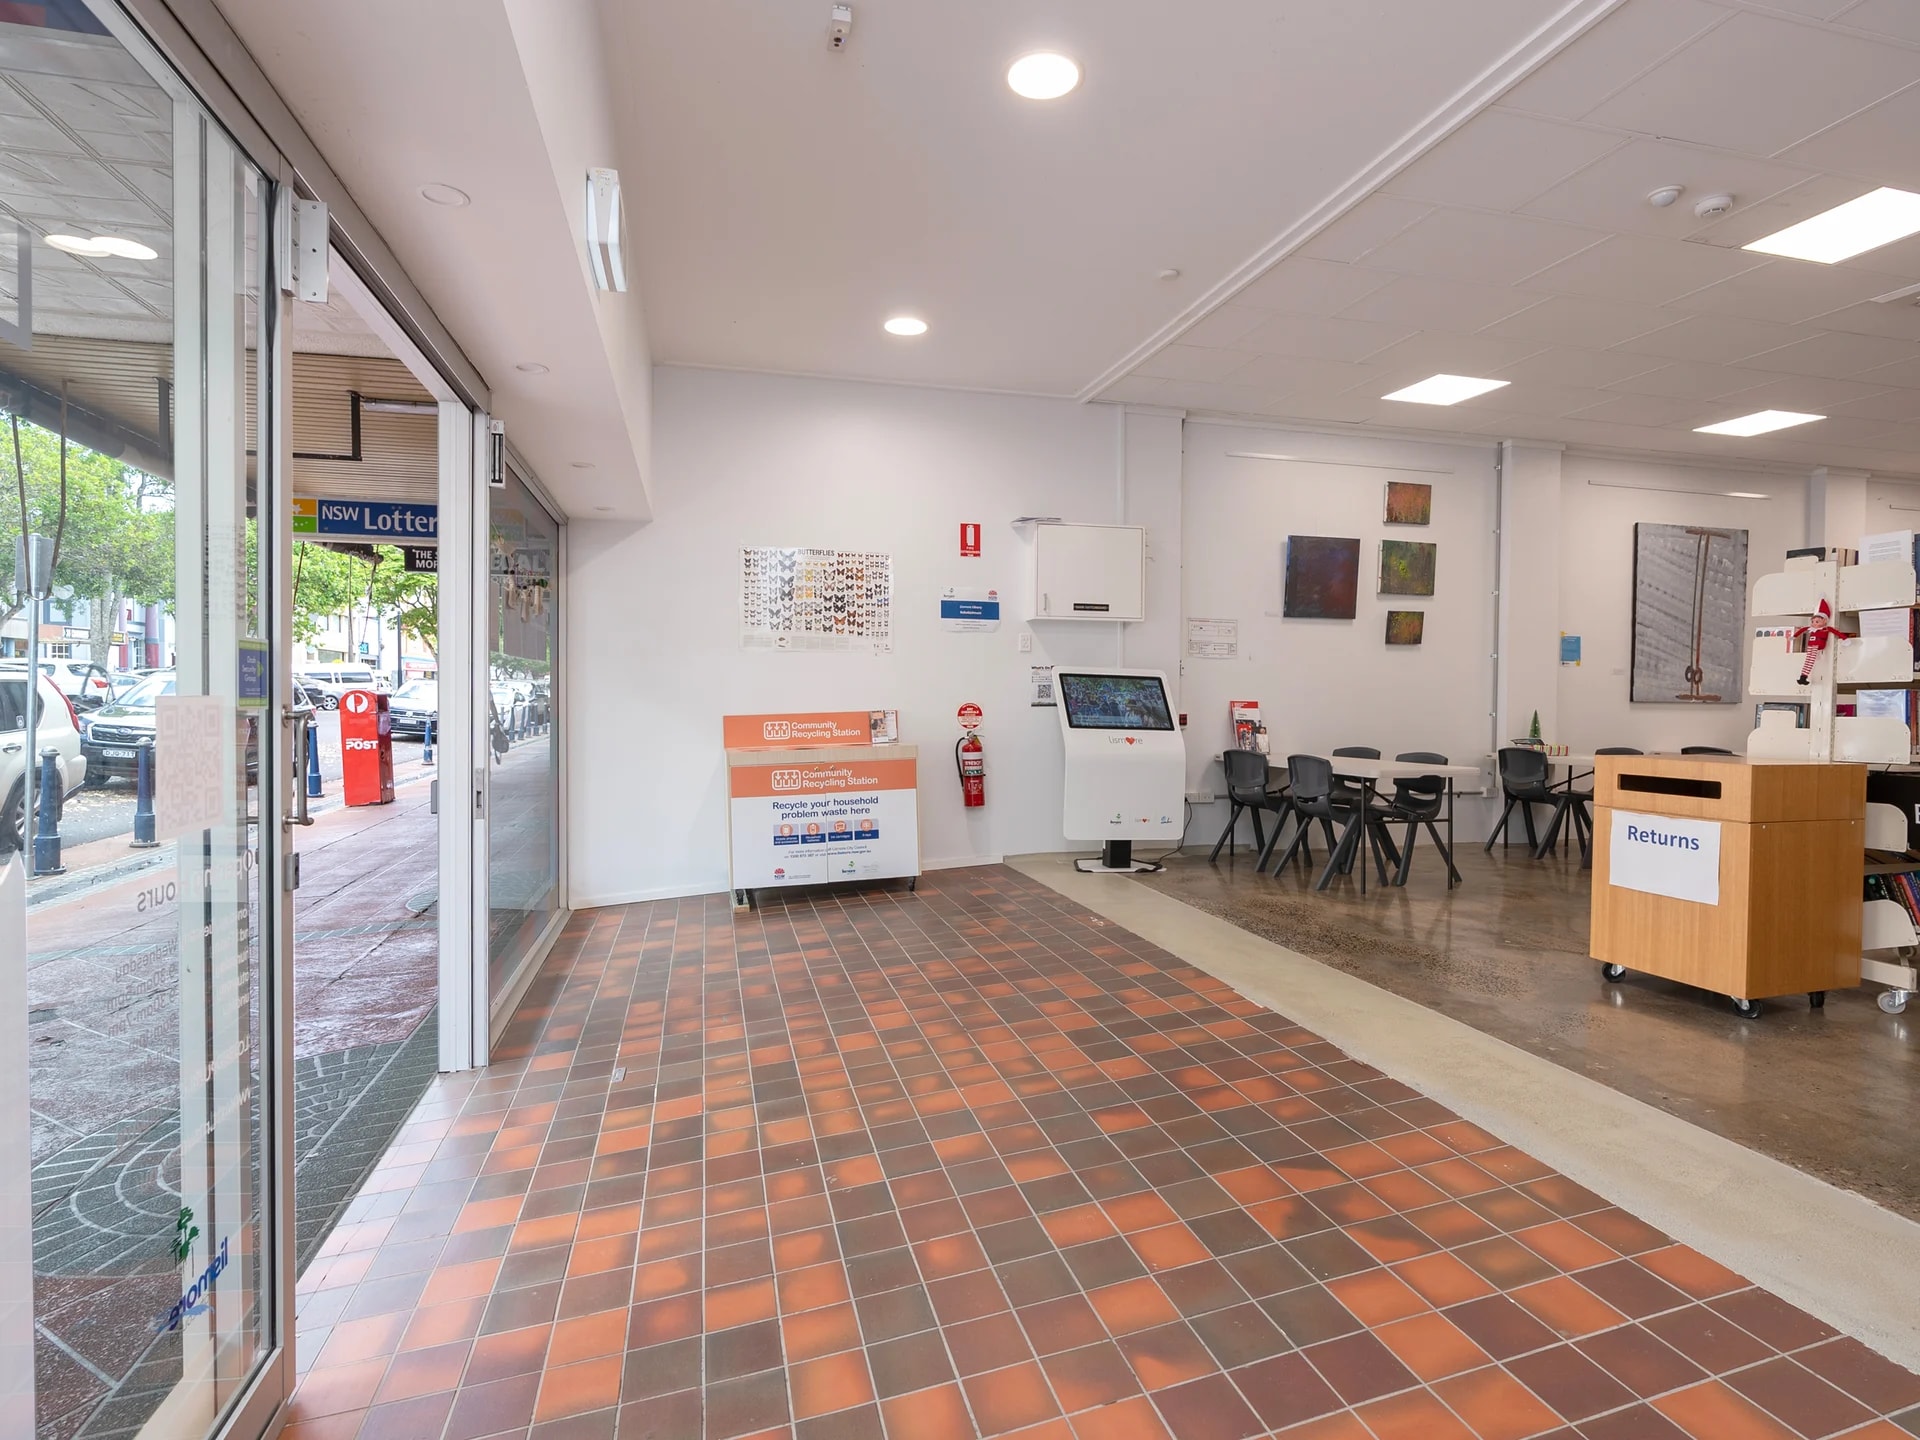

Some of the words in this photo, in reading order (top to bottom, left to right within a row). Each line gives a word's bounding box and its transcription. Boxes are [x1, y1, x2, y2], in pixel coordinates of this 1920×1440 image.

[322, 505, 359, 521] NSW
[364, 507, 437, 532] Lotter
[415, 550, 433, 559] THE
[798, 549, 835, 557] BUTTERFLIES
[791, 721, 837, 731] Community
[791, 729, 831, 739] Recycling
[832, 728, 861, 737] Station
[345, 740, 379, 750] POST
[802, 768, 853, 779] Community
[802, 777, 846, 789] Recycling
[847, 775, 878, 786] Station
[772, 800, 808, 812] Recycle
[810, 799, 830, 810] your
[833, 796, 879, 806] household
[781, 809, 819, 820] problem
[821, 808, 848, 817] waste
[850, 806, 871, 815] here
[1627, 825, 1700, 851] Returns
